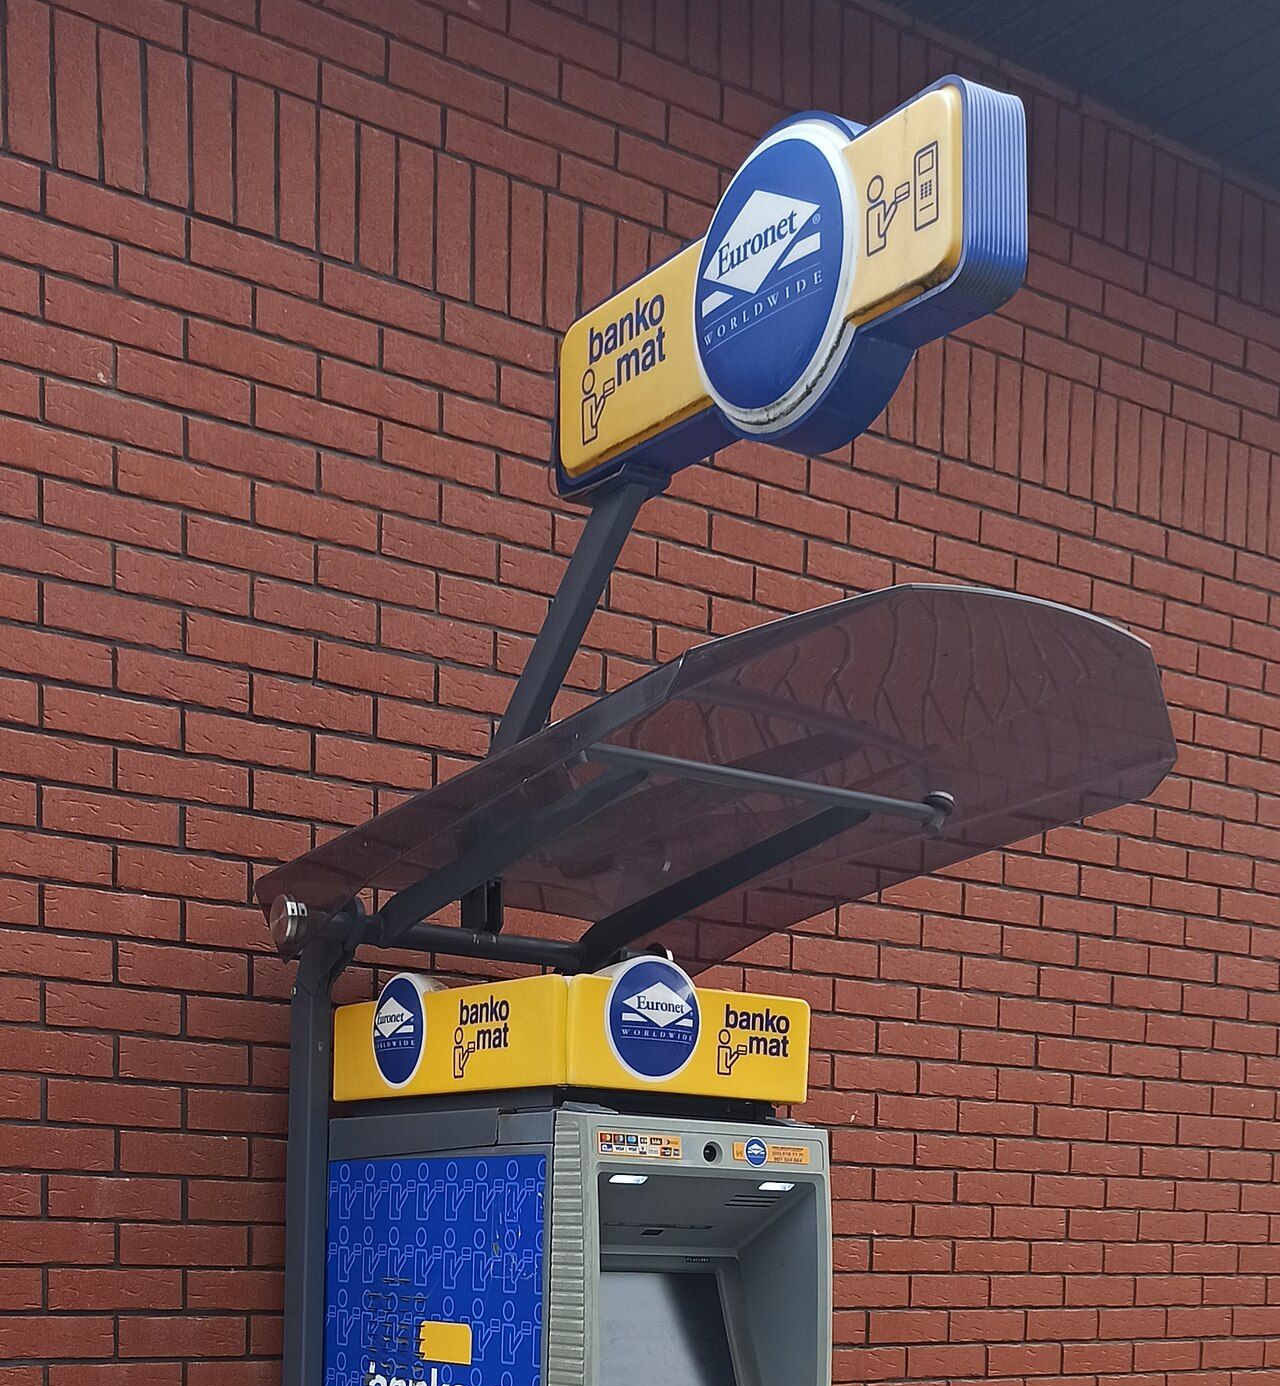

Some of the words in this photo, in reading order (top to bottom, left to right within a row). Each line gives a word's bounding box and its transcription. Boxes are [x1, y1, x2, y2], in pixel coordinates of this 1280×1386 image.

[716, 211, 799, 280] Euronet
[702, 269, 824, 346] WORLDWIDE
[587, 293, 665, 365] banko
[616, 329, 667, 388] mat
[459, 995, 510, 1026] banko
[636, 995, 685, 1014] Euronet
[725, 1004, 790, 1034] banko
[476, 1022, 509, 1050] mat
[621, 1028, 693, 1042] WORLDWIDE
[748, 1034, 789, 1057] mat
